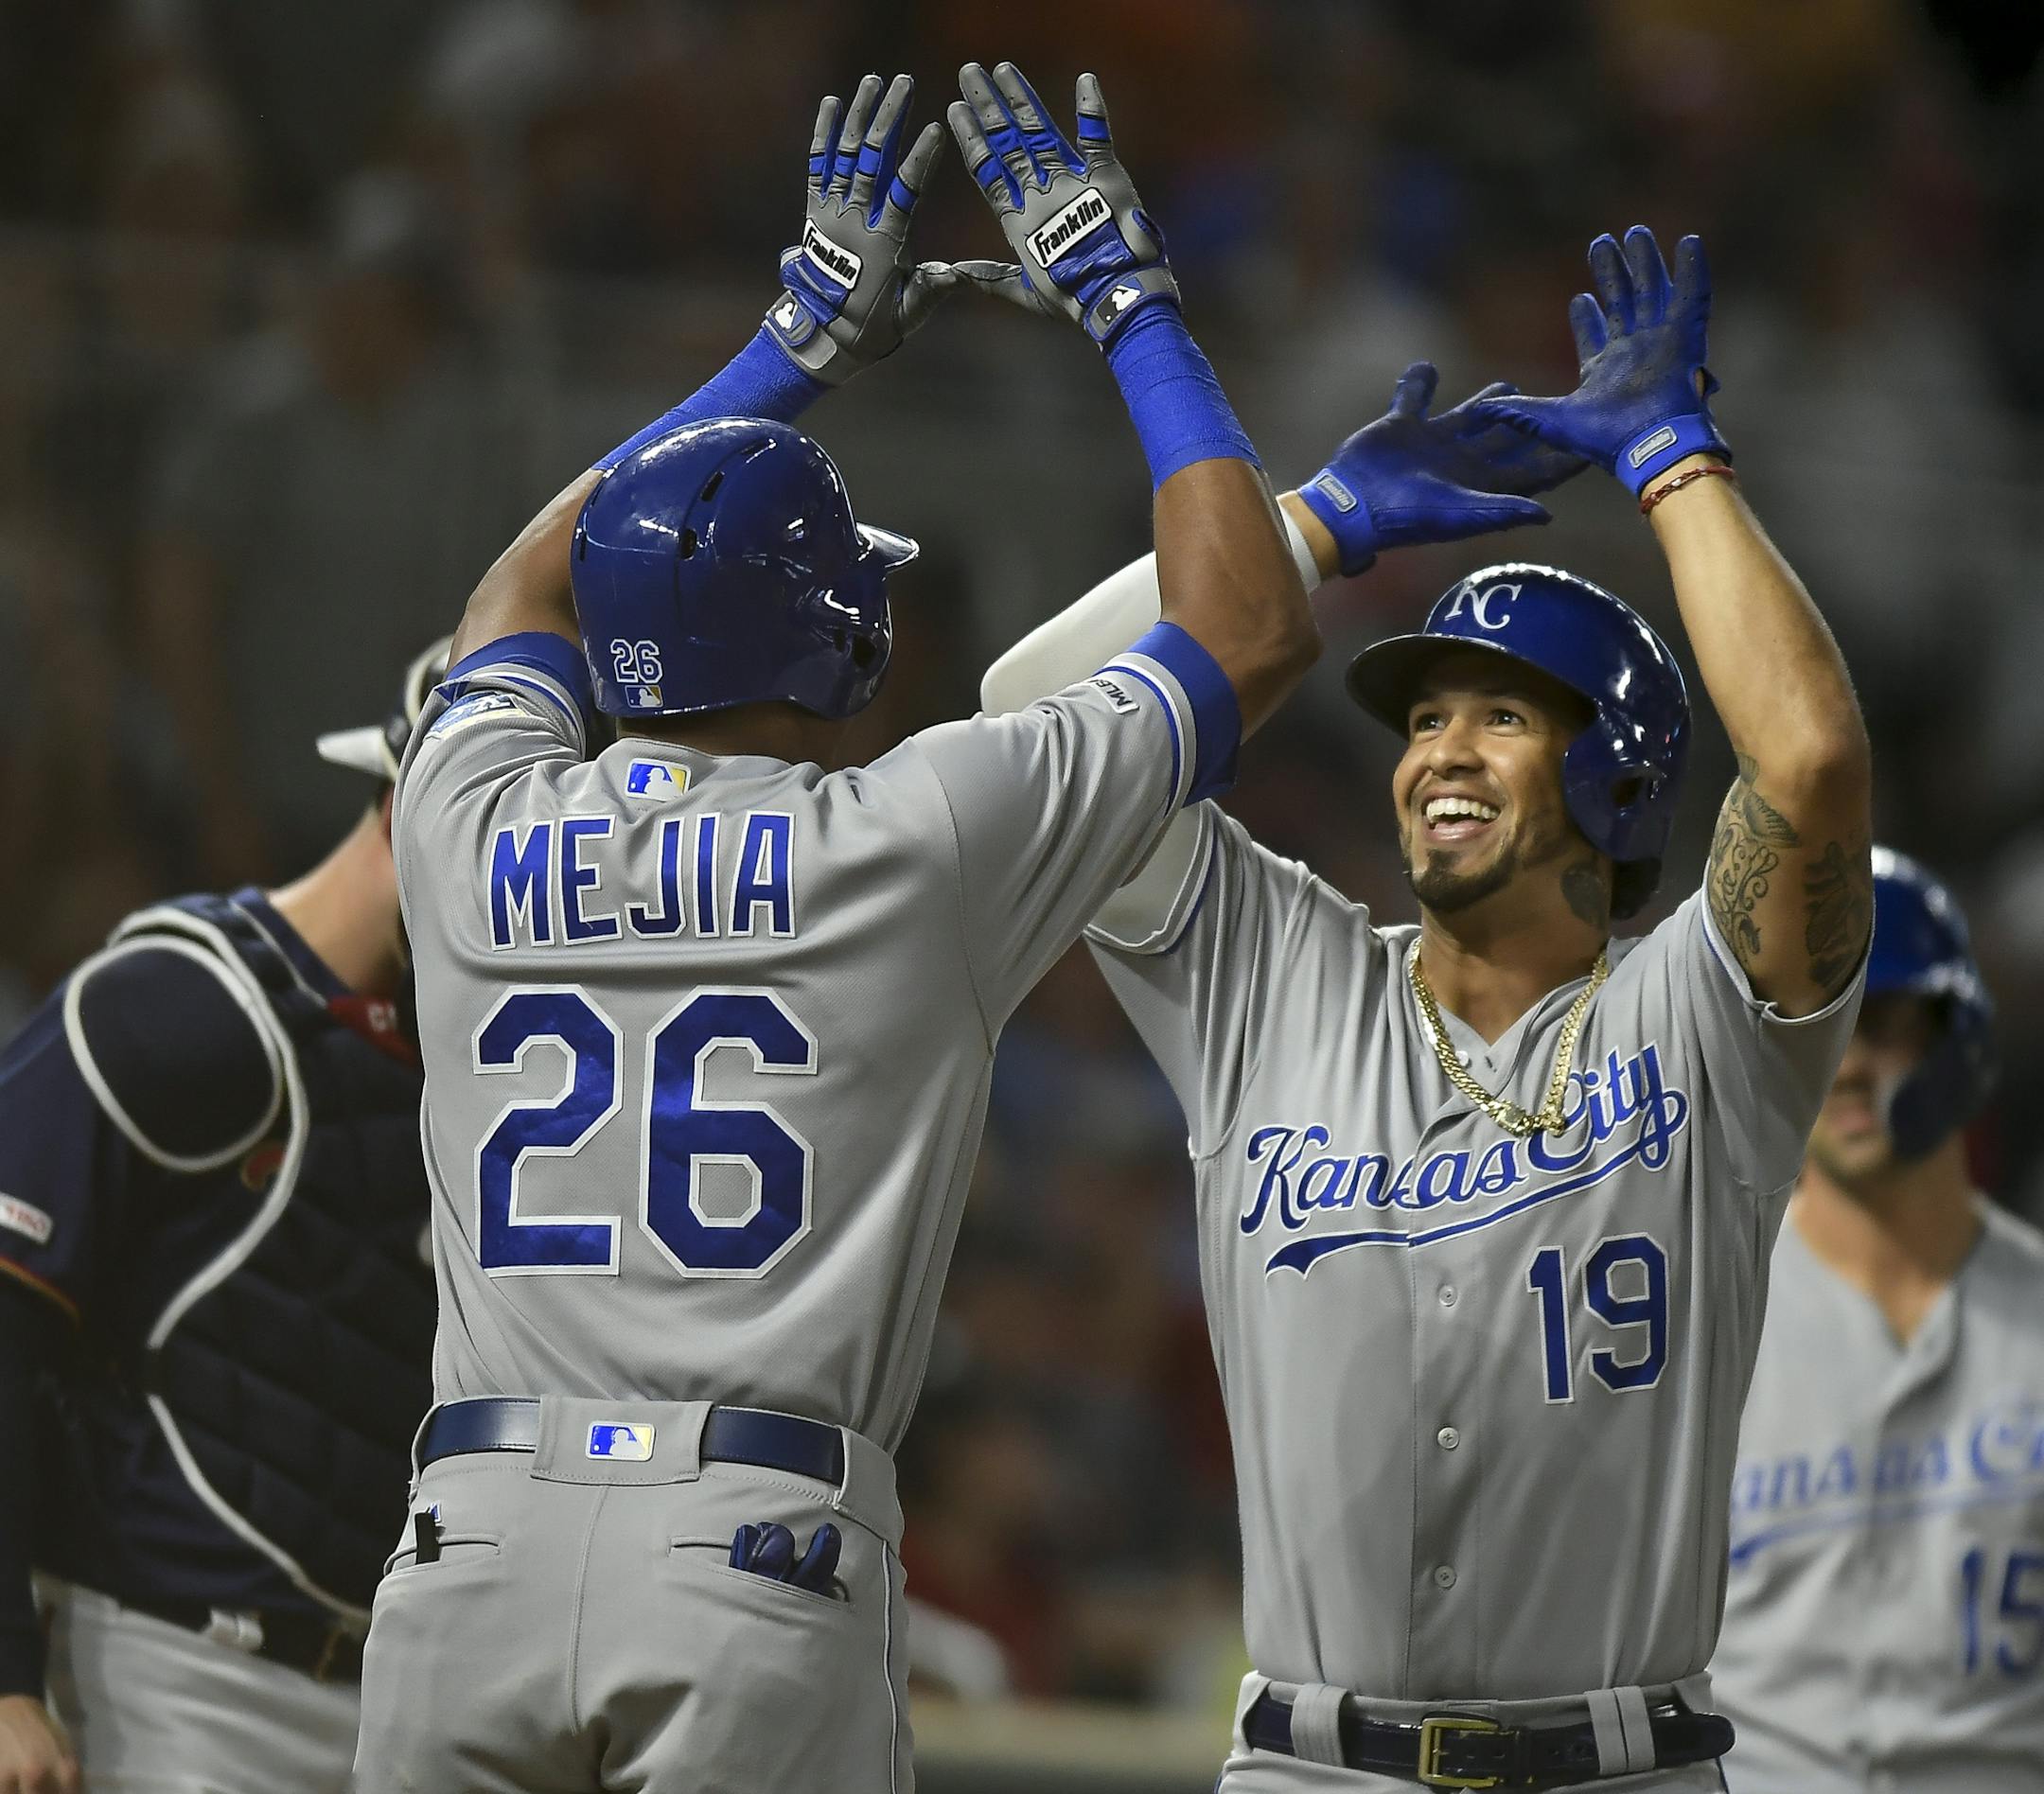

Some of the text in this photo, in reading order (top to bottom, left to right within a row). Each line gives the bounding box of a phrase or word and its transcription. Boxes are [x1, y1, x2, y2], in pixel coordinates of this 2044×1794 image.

[803, 226, 857, 282] Franklin
[1033, 197, 1105, 266] Franklin
[610, 639, 663, 684] 26
[487, 810, 797, 952] MEJIA
[471, 984, 819, 1279] 26
[1525, 1232, 1670, 1405] 19
[1961, 1545, 2044, 1680] 15
